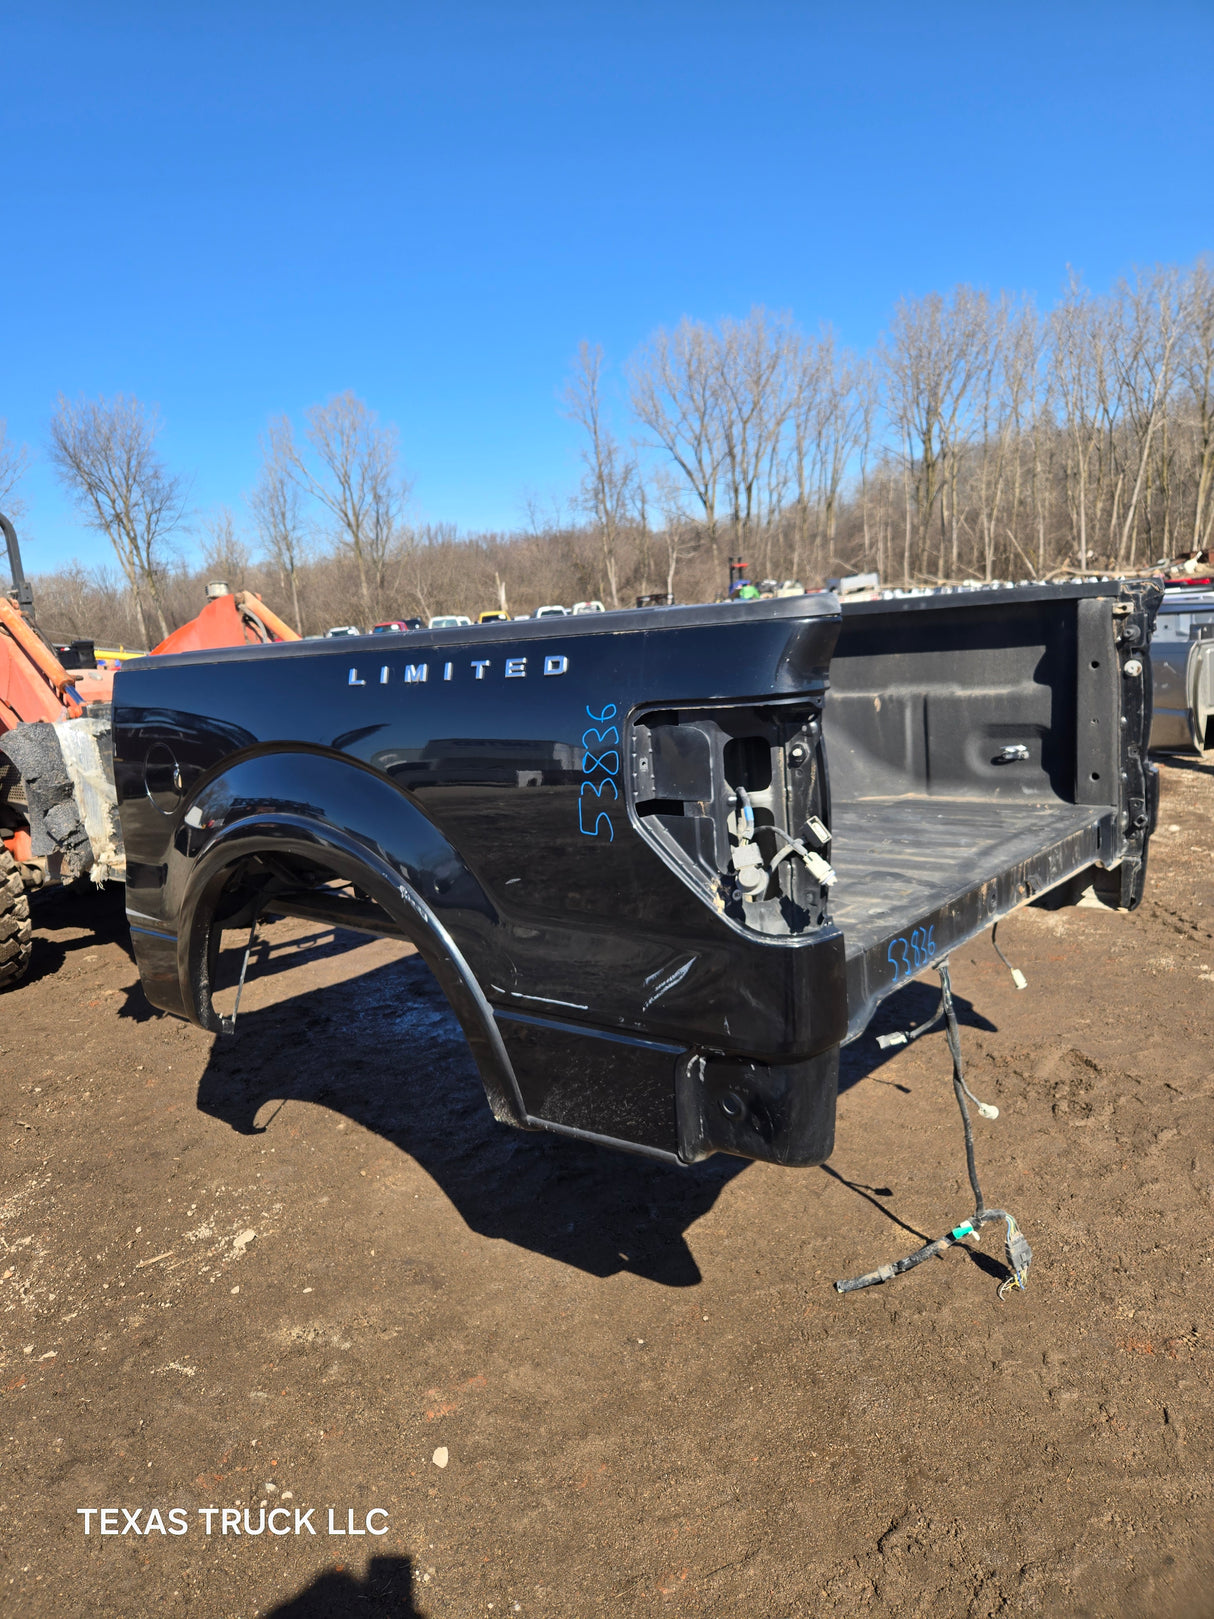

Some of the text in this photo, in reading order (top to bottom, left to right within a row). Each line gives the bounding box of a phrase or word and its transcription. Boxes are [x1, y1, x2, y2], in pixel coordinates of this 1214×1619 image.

[348, 655, 569, 686] LIMITED
[578, 703, 620, 842] 53836
[887, 924, 936, 982] 53836
